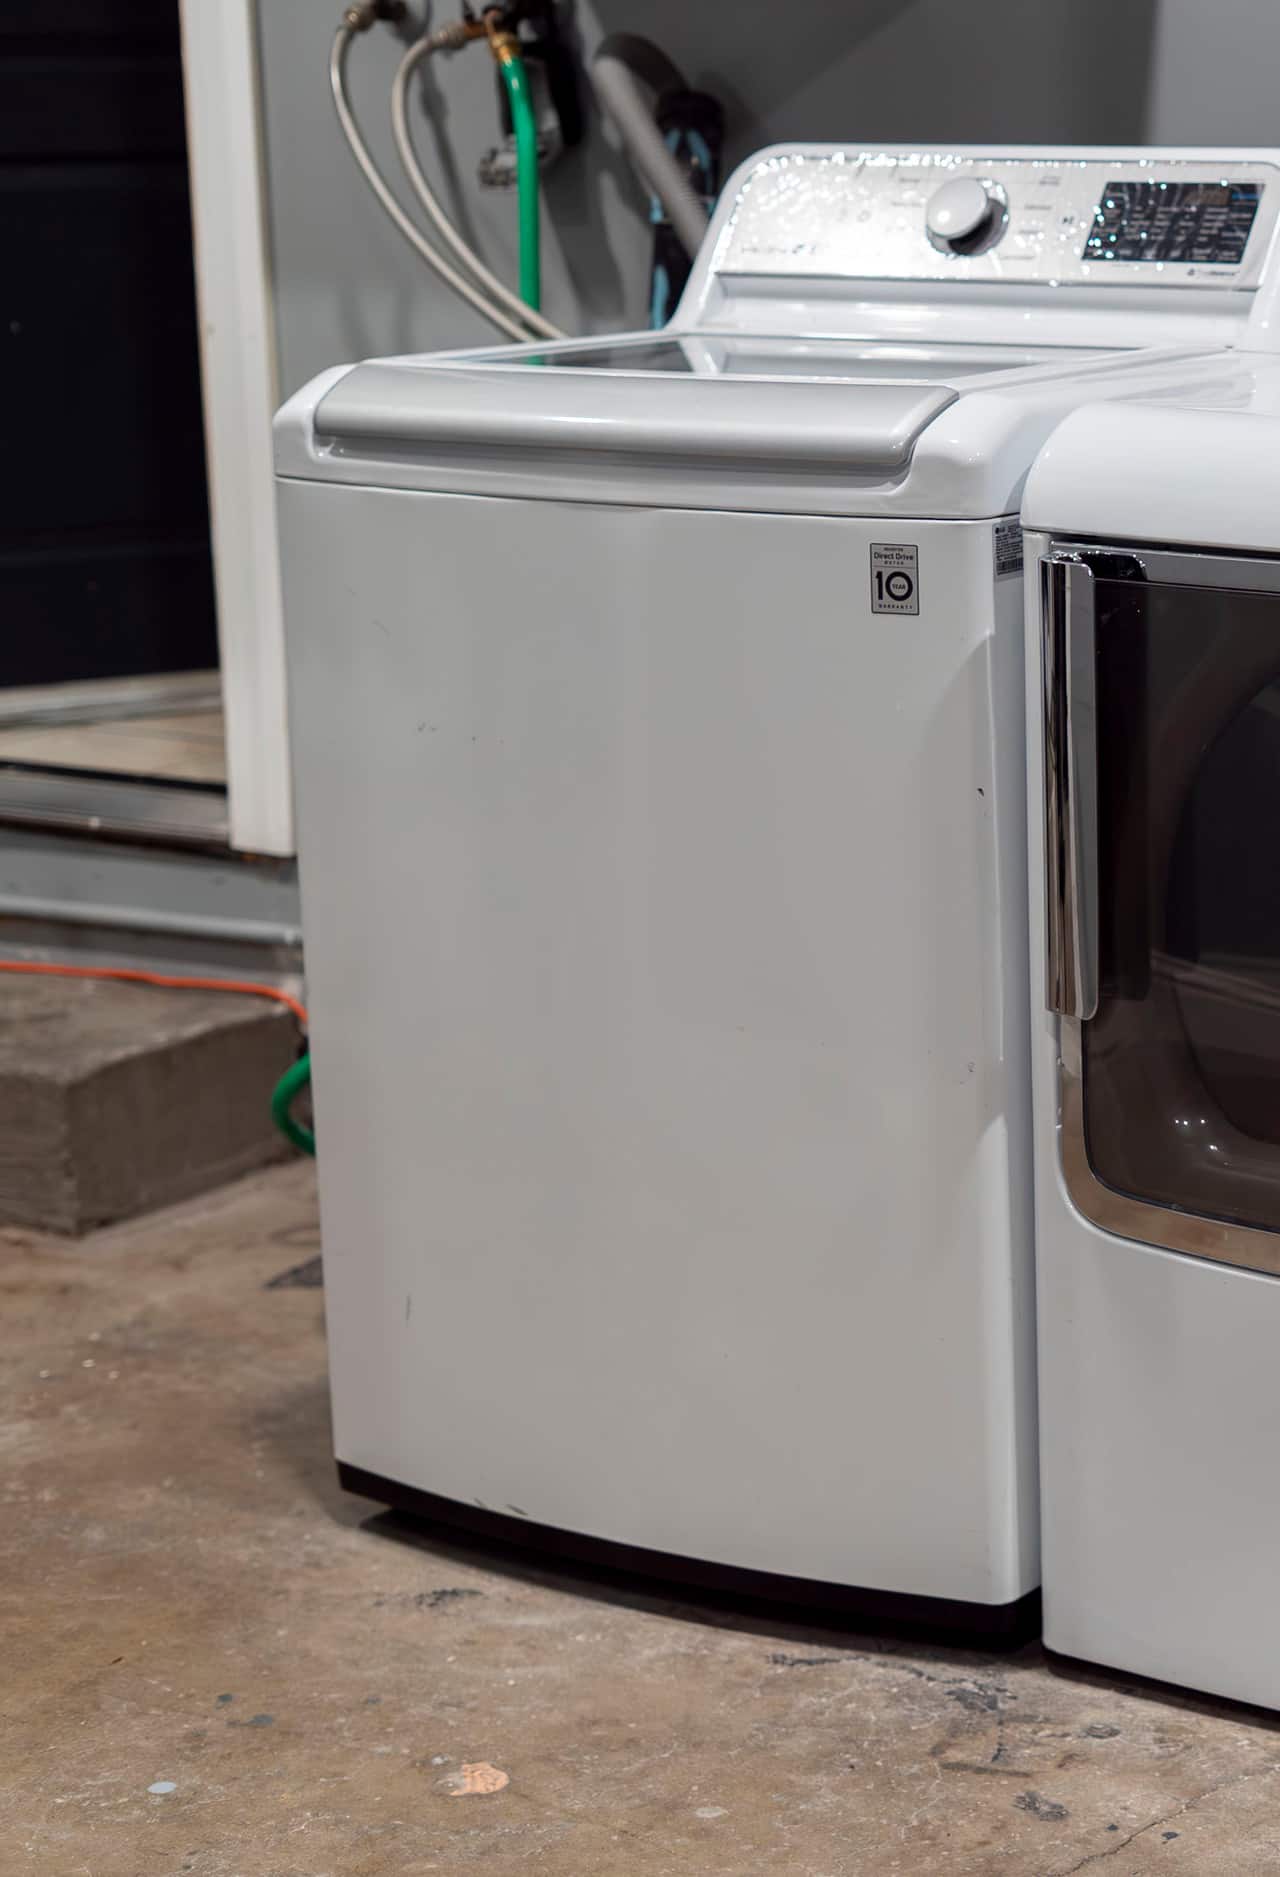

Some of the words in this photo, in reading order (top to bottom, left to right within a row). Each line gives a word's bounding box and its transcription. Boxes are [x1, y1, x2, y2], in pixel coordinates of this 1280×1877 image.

[874, 552, 894, 560] Direct
[895, 552, 914, 561] Drive
[876, 570, 914, 602] 10
